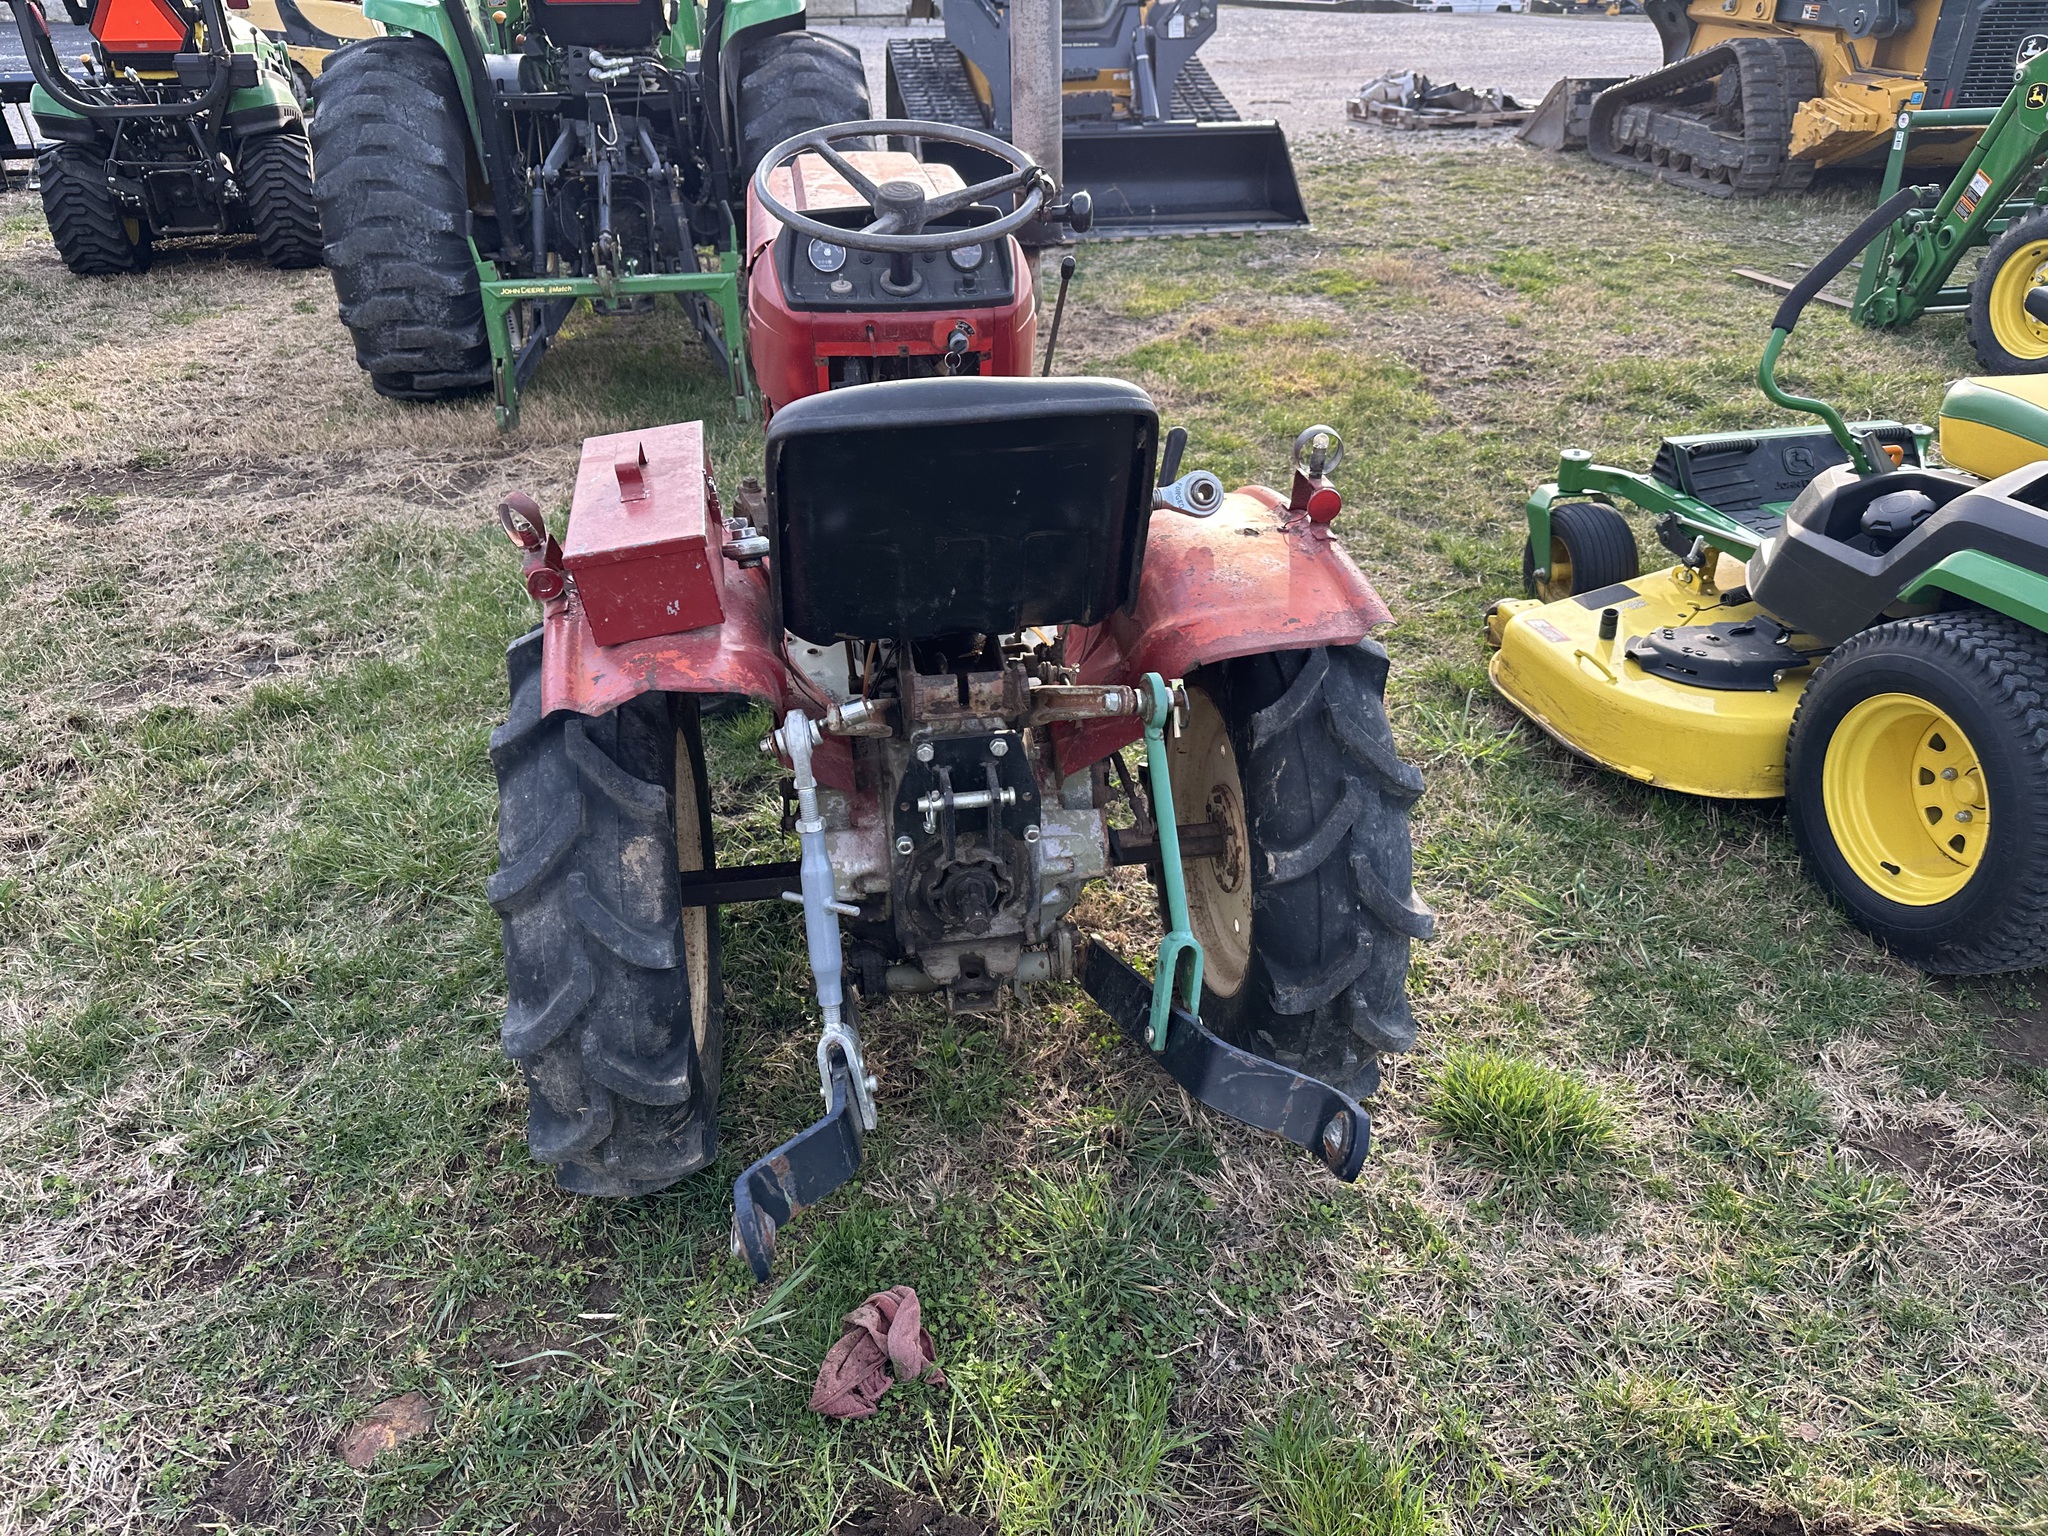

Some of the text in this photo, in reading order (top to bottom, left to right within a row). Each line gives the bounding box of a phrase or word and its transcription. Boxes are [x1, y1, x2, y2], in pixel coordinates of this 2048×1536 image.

[501, 287, 520, 295] JOHN
[1775, 481, 1800, 490] JOHN
[1175, 482, 1185, 509] FORGED
